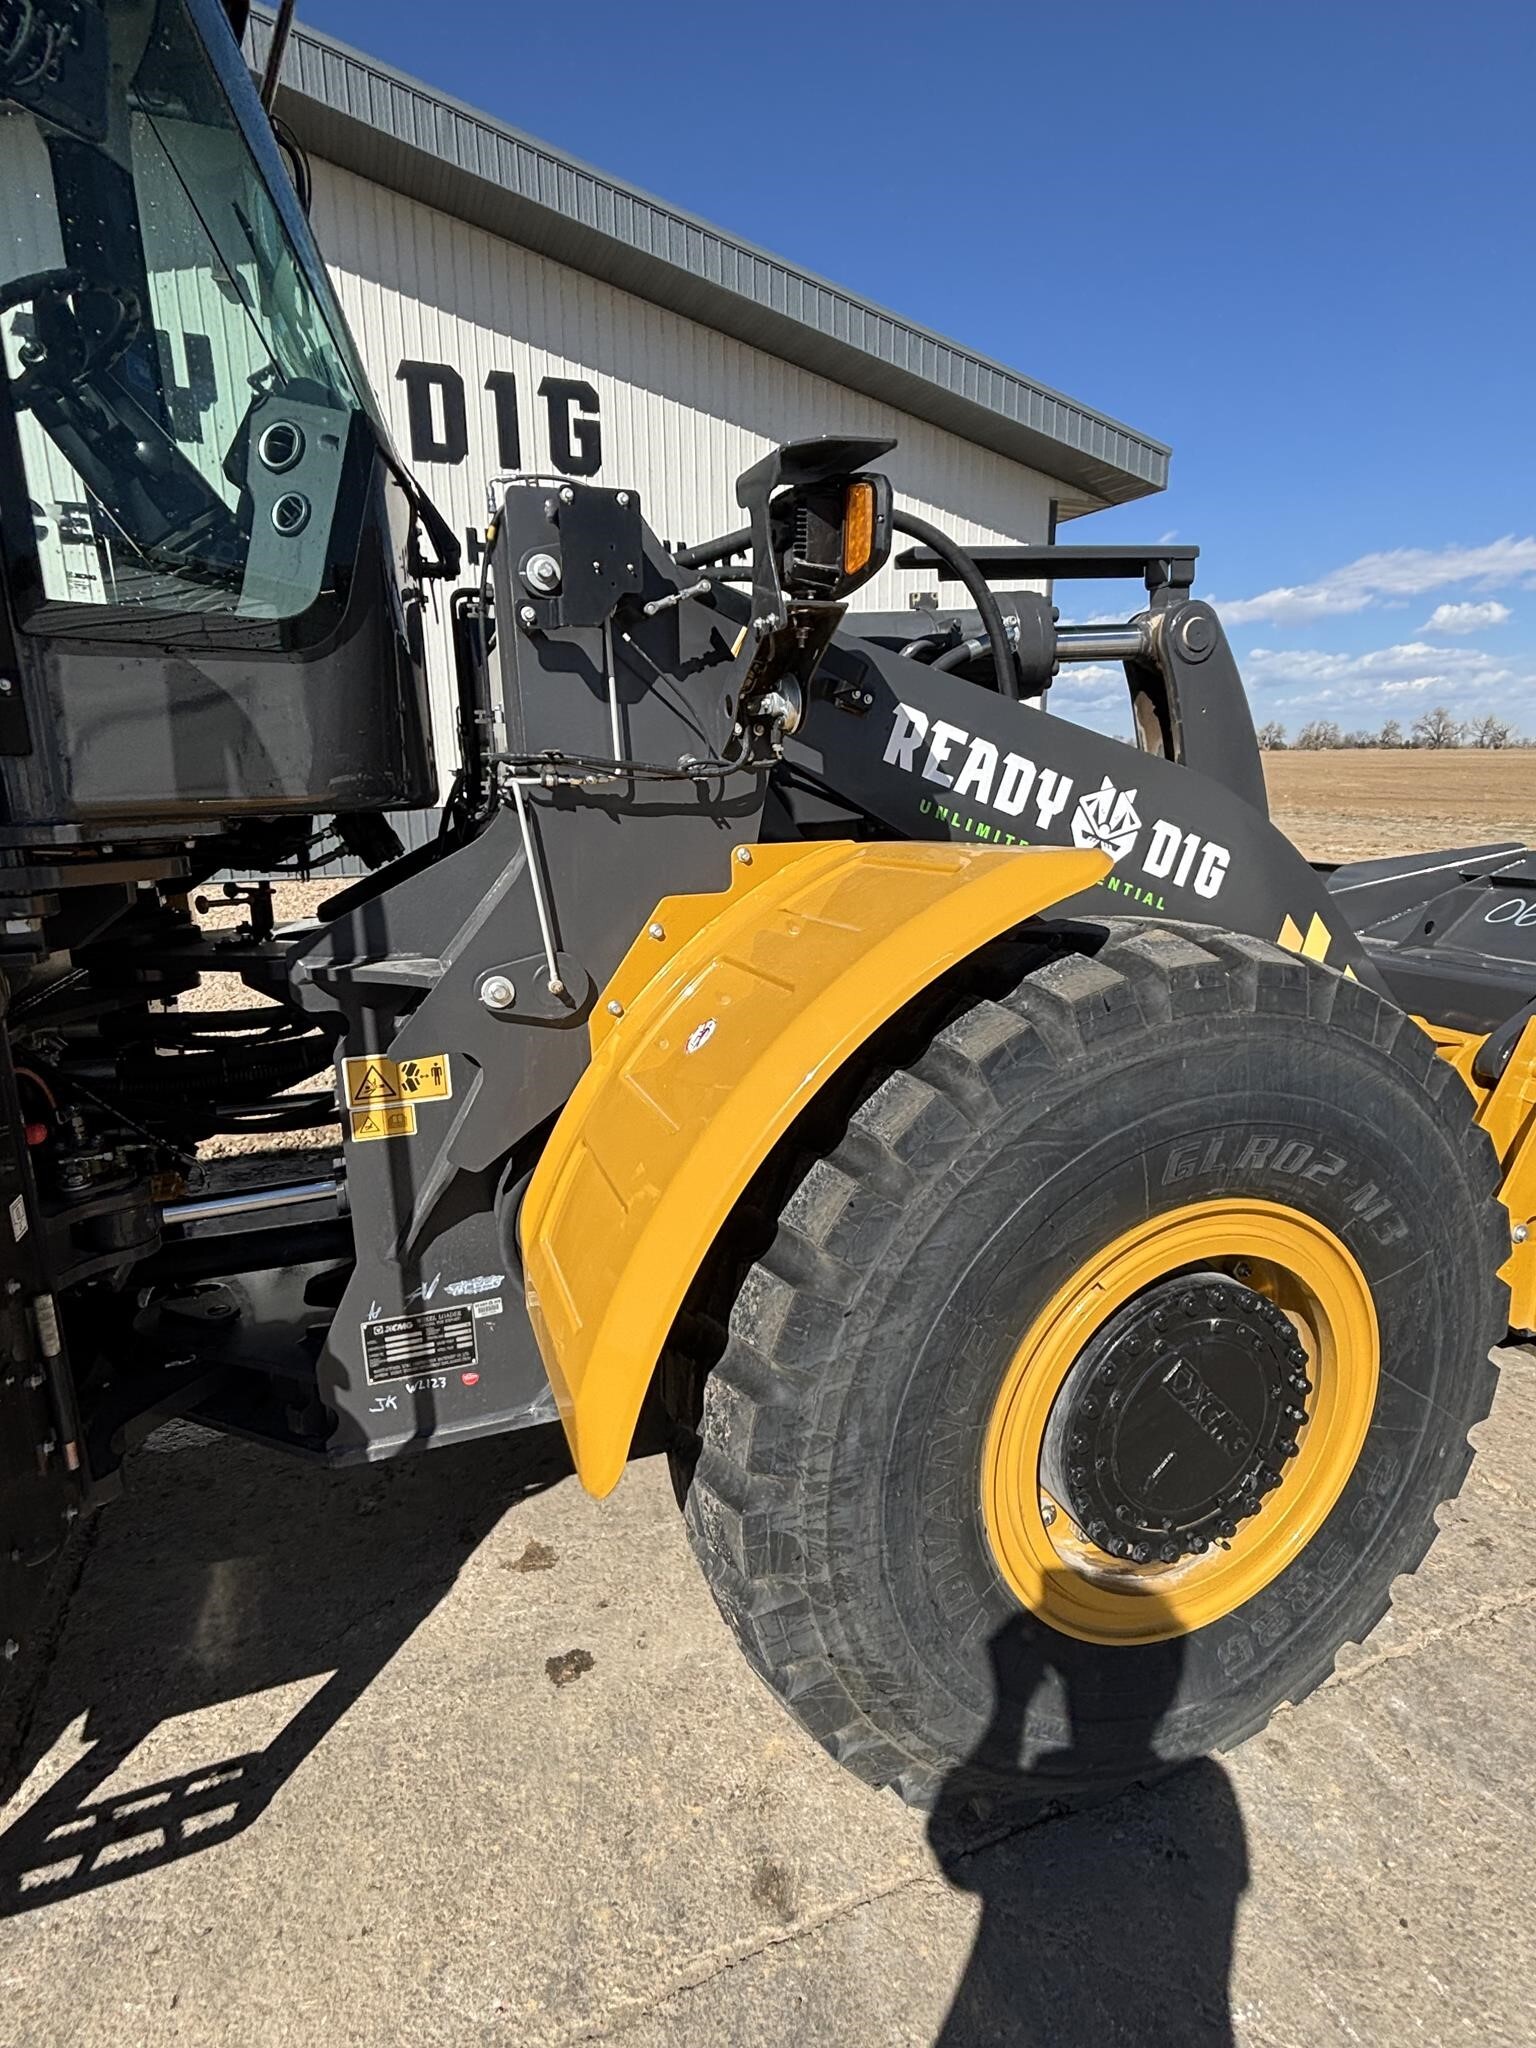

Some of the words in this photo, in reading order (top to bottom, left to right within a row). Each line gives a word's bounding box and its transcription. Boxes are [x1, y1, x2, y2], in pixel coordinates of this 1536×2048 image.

[396, 359, 602, 478] DIG
[882, 702, 1074, 830] READY
[1142, 819, 1231, 899] DIG
[1096, 876, 1165, 911] NTIAL
[369, 1395, 398, 1413] JK
